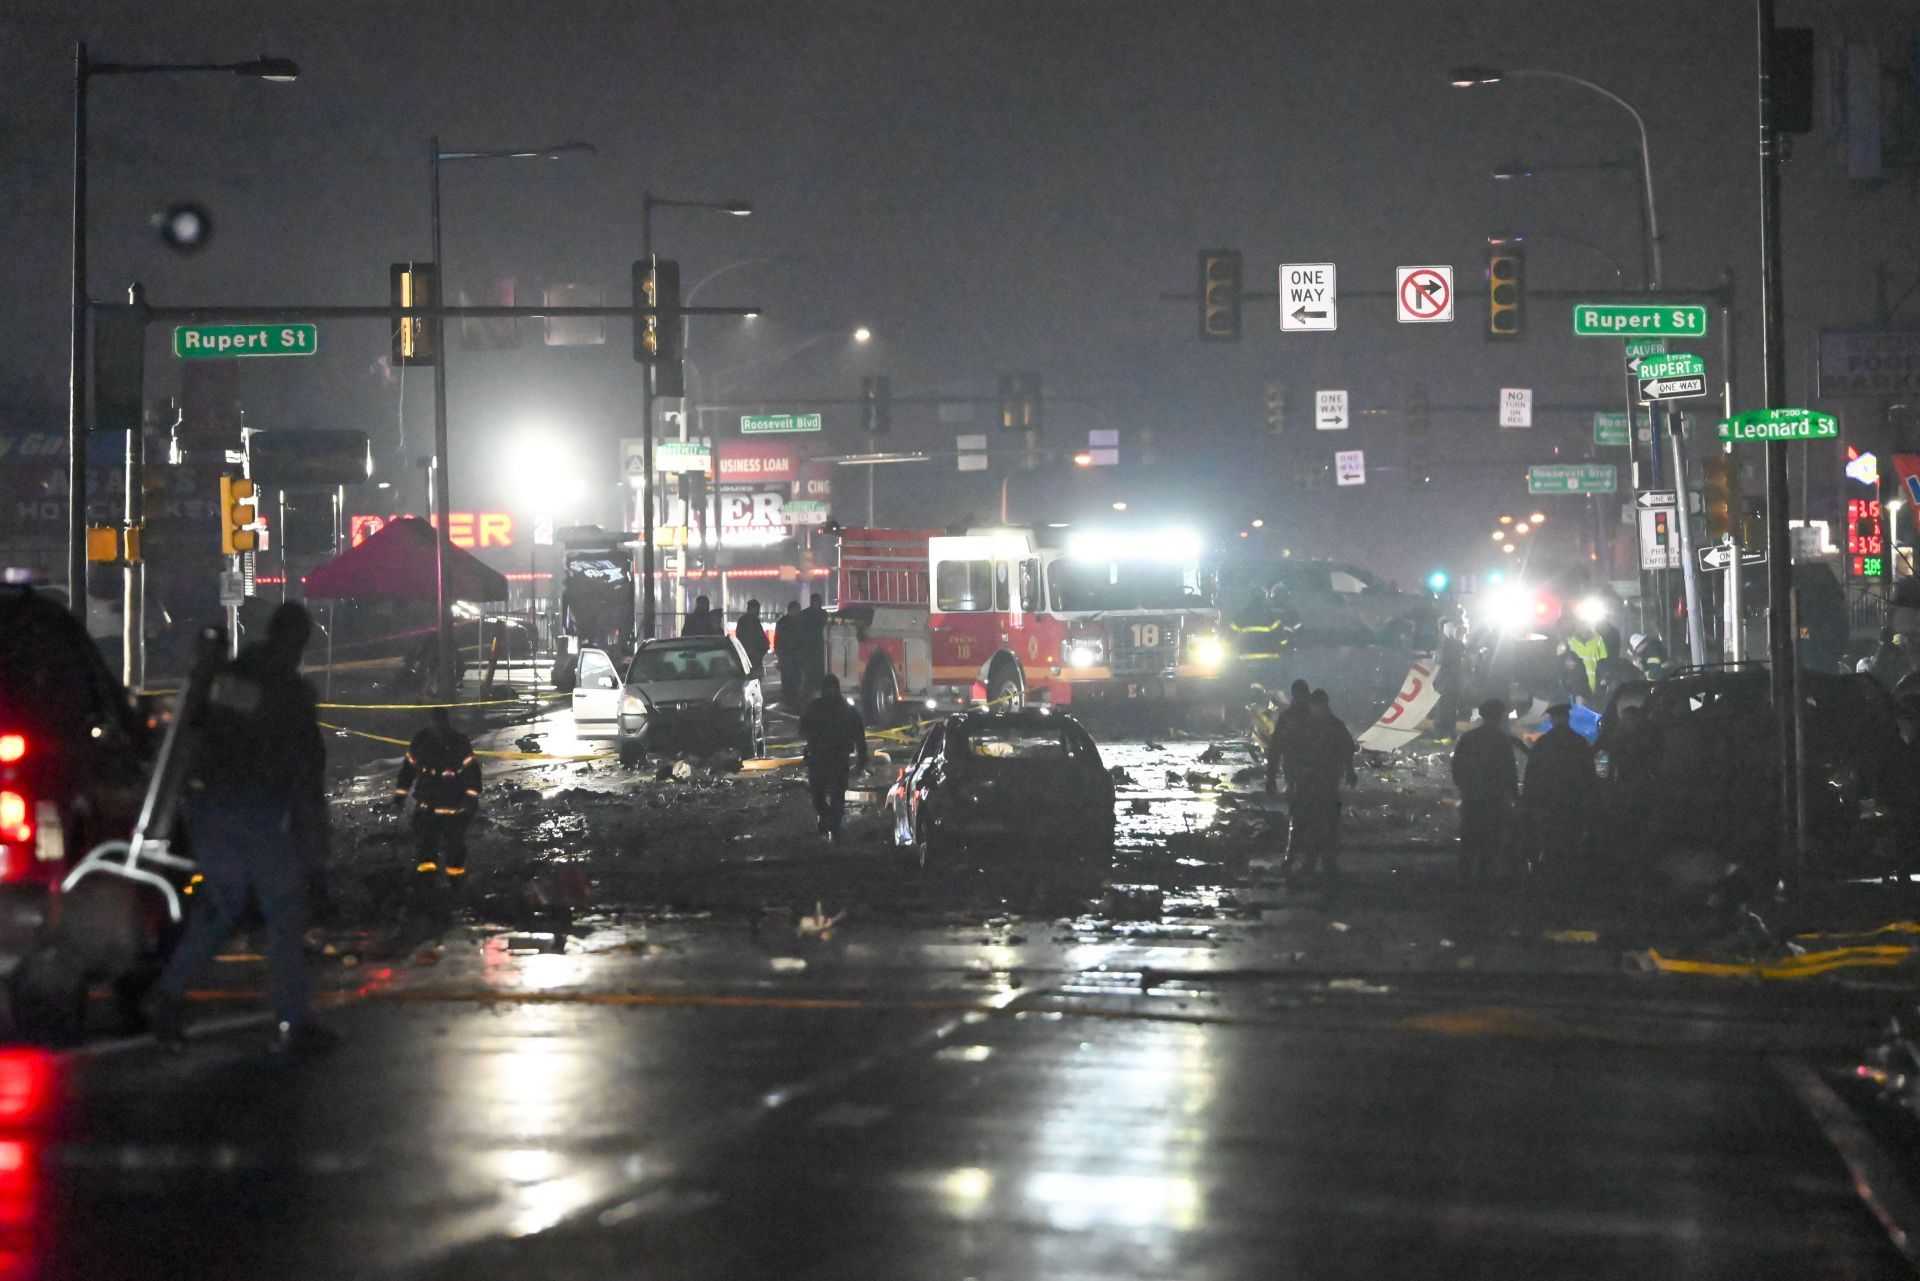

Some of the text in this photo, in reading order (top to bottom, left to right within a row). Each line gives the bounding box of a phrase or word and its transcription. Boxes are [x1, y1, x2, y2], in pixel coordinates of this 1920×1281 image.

[1291, 271, 1324, 285] ONE
[1290, 288, 1325, 303] WAY
[1585, 311, 1696, 331] Rupert St
[185, 329, 306, 351] Rupert St
[1641, 361, 1702, 378] RUPERT ST
[1659, 380, 1698, 393] ONE WAY
[1320, 394, 1343, 403] ONE
[1508, 392, 1524, 400] NO
[1320, 405, 1343, 413] WAY
[743, 416, 819, 430] Roosevelt Blvd
[1734, 418, 1835, 439] Leonard St
[719, 458, 760, 473] USINESS
[764, 457, 789, 472] LOAN
[1339, 454, 1360, 462] ONE
[1340, 463, 1360, 471] WAY
[1650, 494, 1676, 503] ONE WA
[1651, 547, 1675, 555] PHOO
[1719, 552, 1731, 561] ON
[1130, 623, 1159, 648] 18
[957, 644, 971, 660] 18
